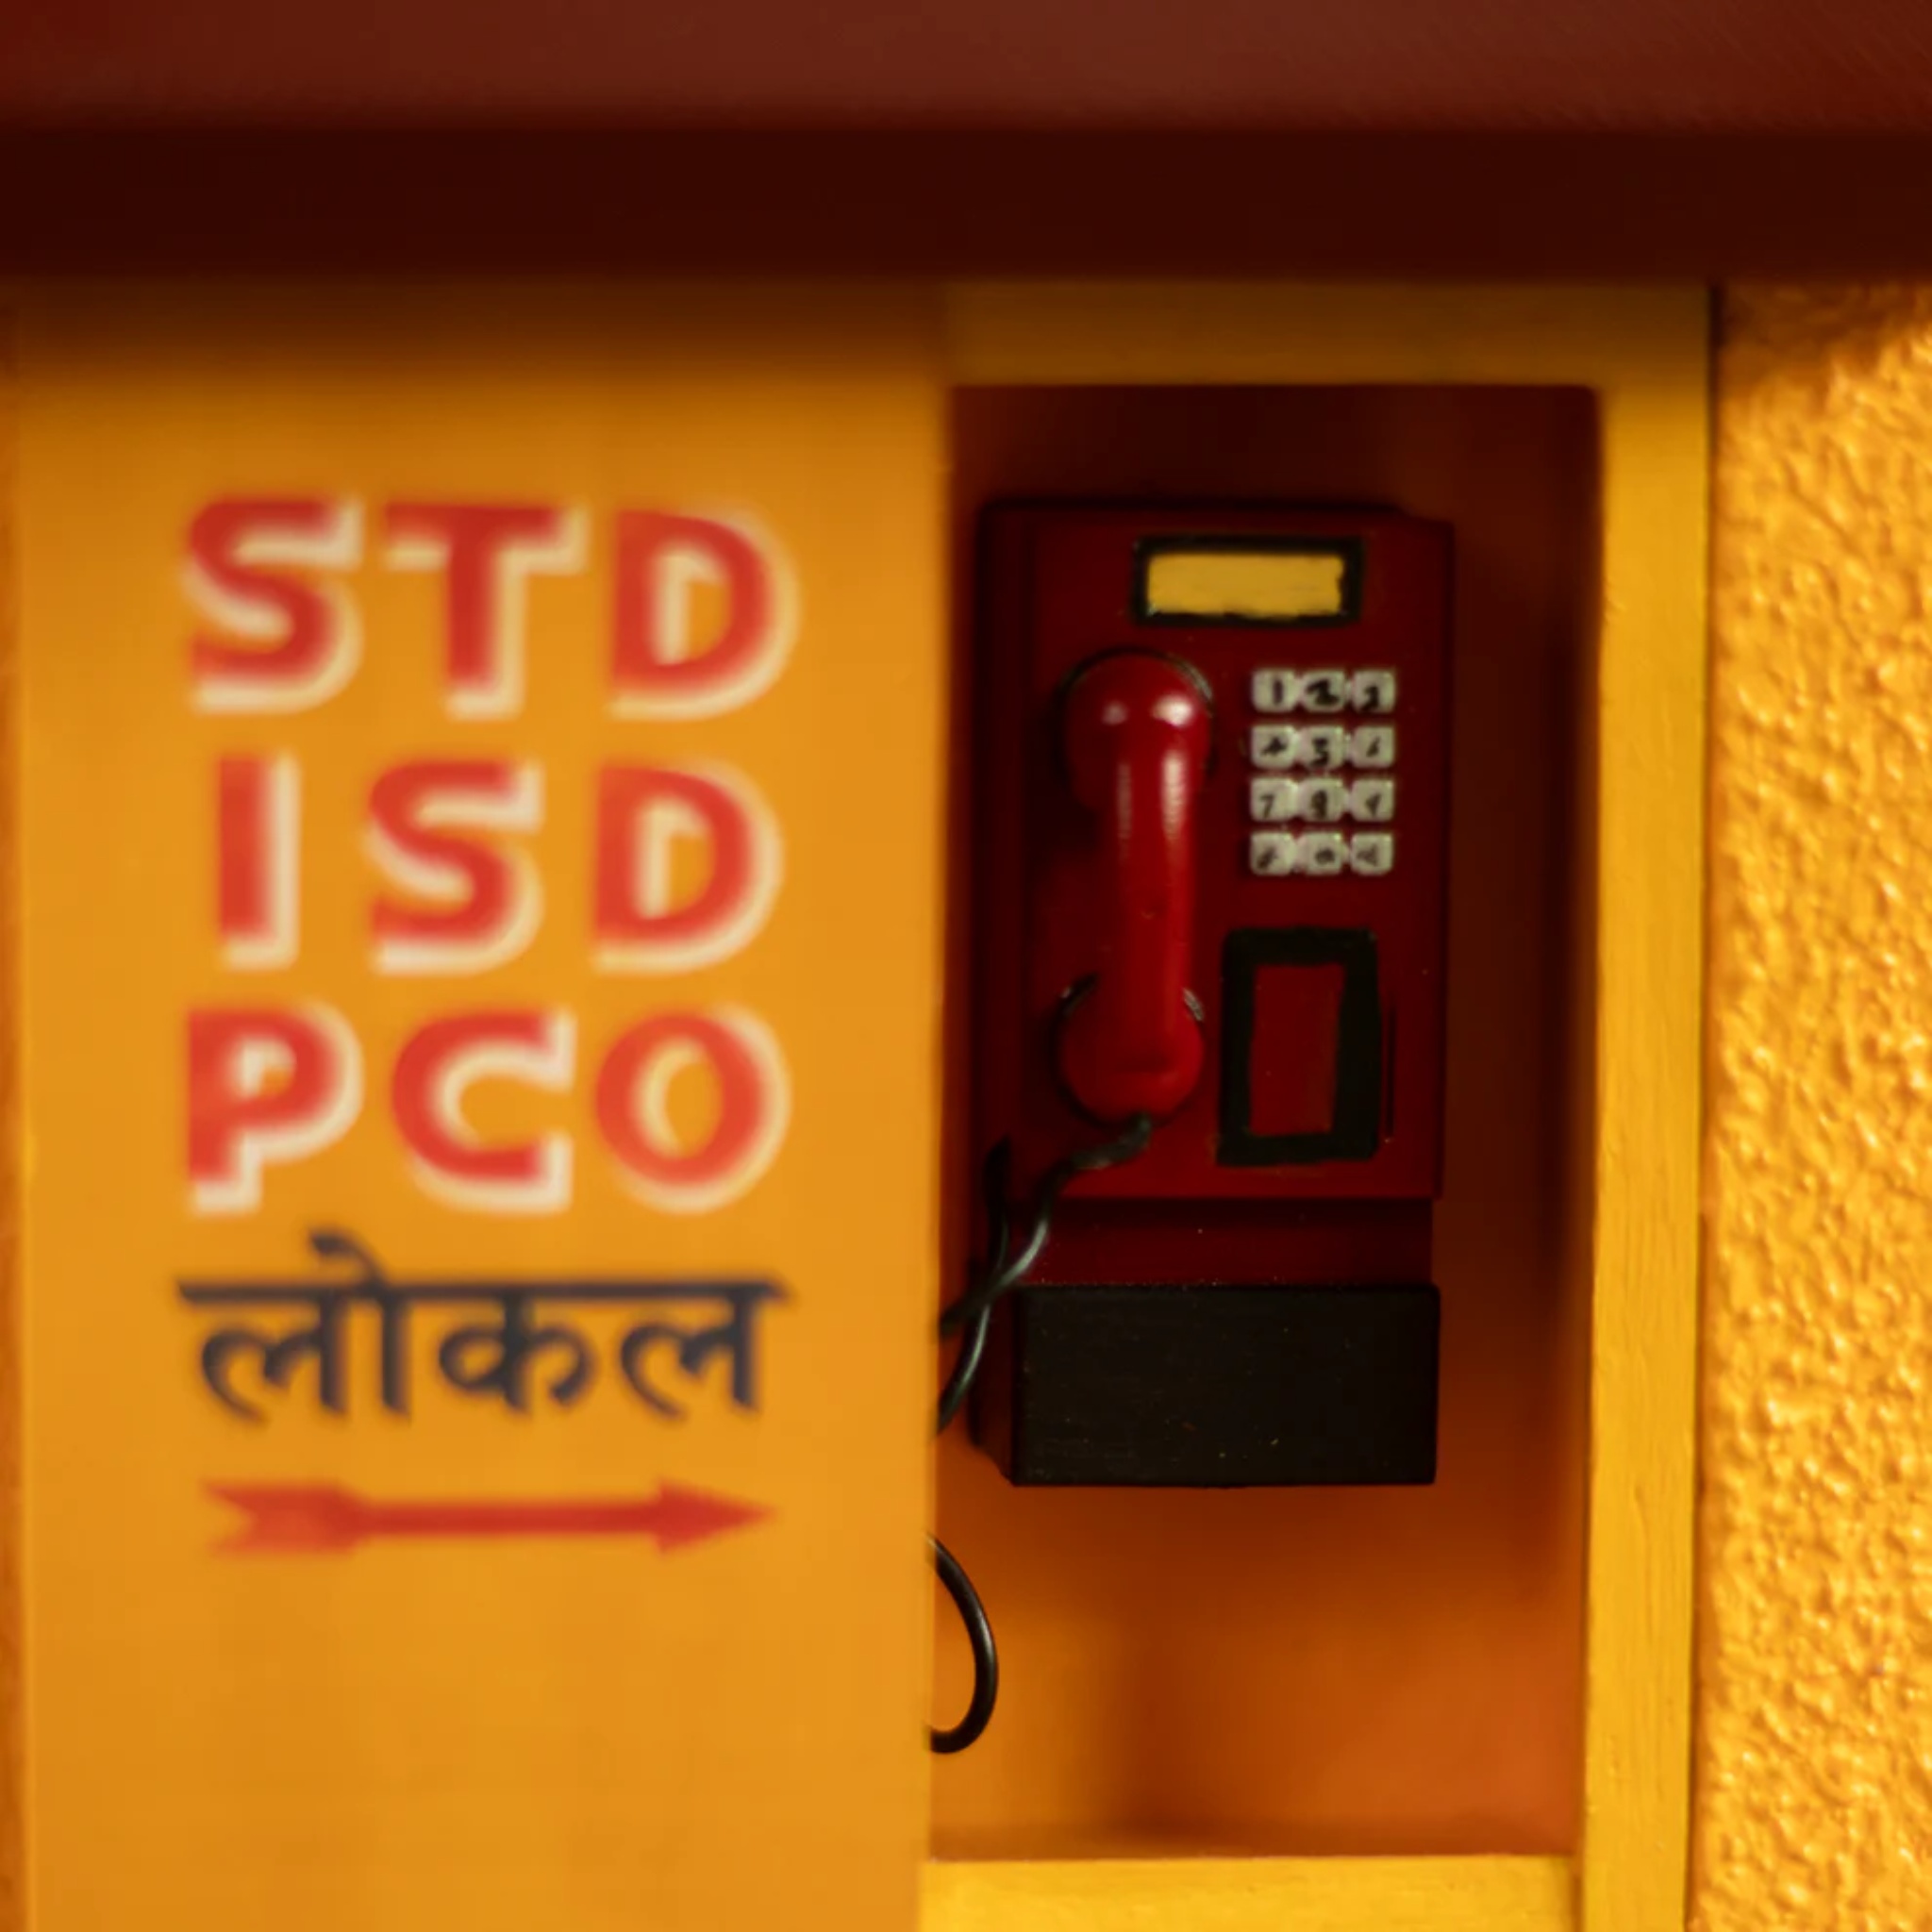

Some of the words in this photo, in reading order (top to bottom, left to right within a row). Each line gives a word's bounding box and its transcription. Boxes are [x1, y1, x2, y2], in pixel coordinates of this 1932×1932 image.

[183, 494, 802, 721] STD
[214, 753, 787, 976] ISD
[184, 998, 792, 1215] PCO
[175, 1225, 794, 1426] लोकल
